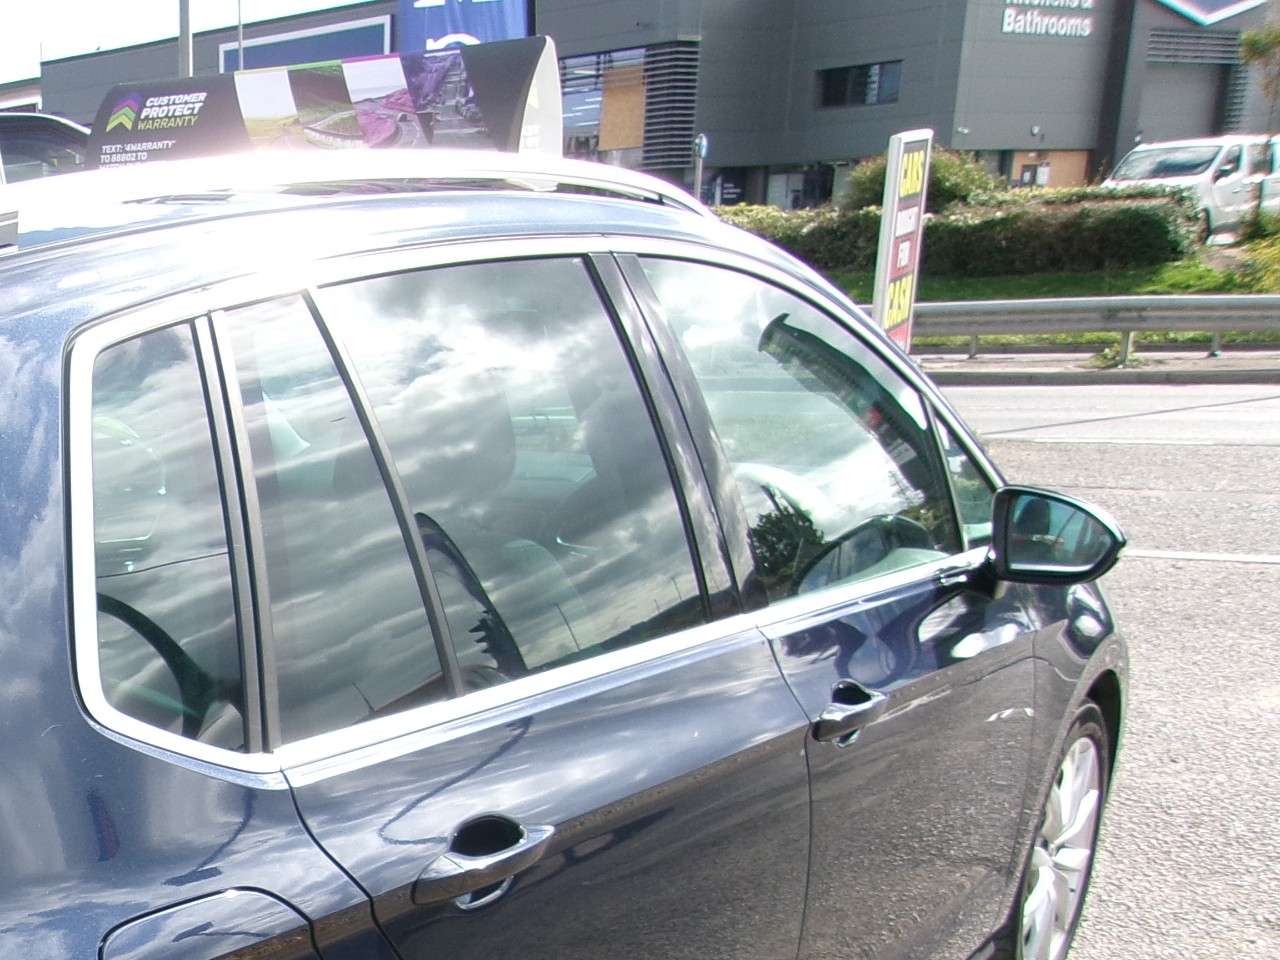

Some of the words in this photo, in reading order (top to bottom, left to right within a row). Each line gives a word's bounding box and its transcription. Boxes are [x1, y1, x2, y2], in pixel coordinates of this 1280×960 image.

[1002, 6, 1092, 37] Bathrooms
[145, 92, 208, 107] CUSTOMER
[140, 103, 203, 119] PROTECT
[137, 116, 199, 130] WARRANTY
[100, 154, 110, 163] TO
[137, 152, 148, 161] TO
